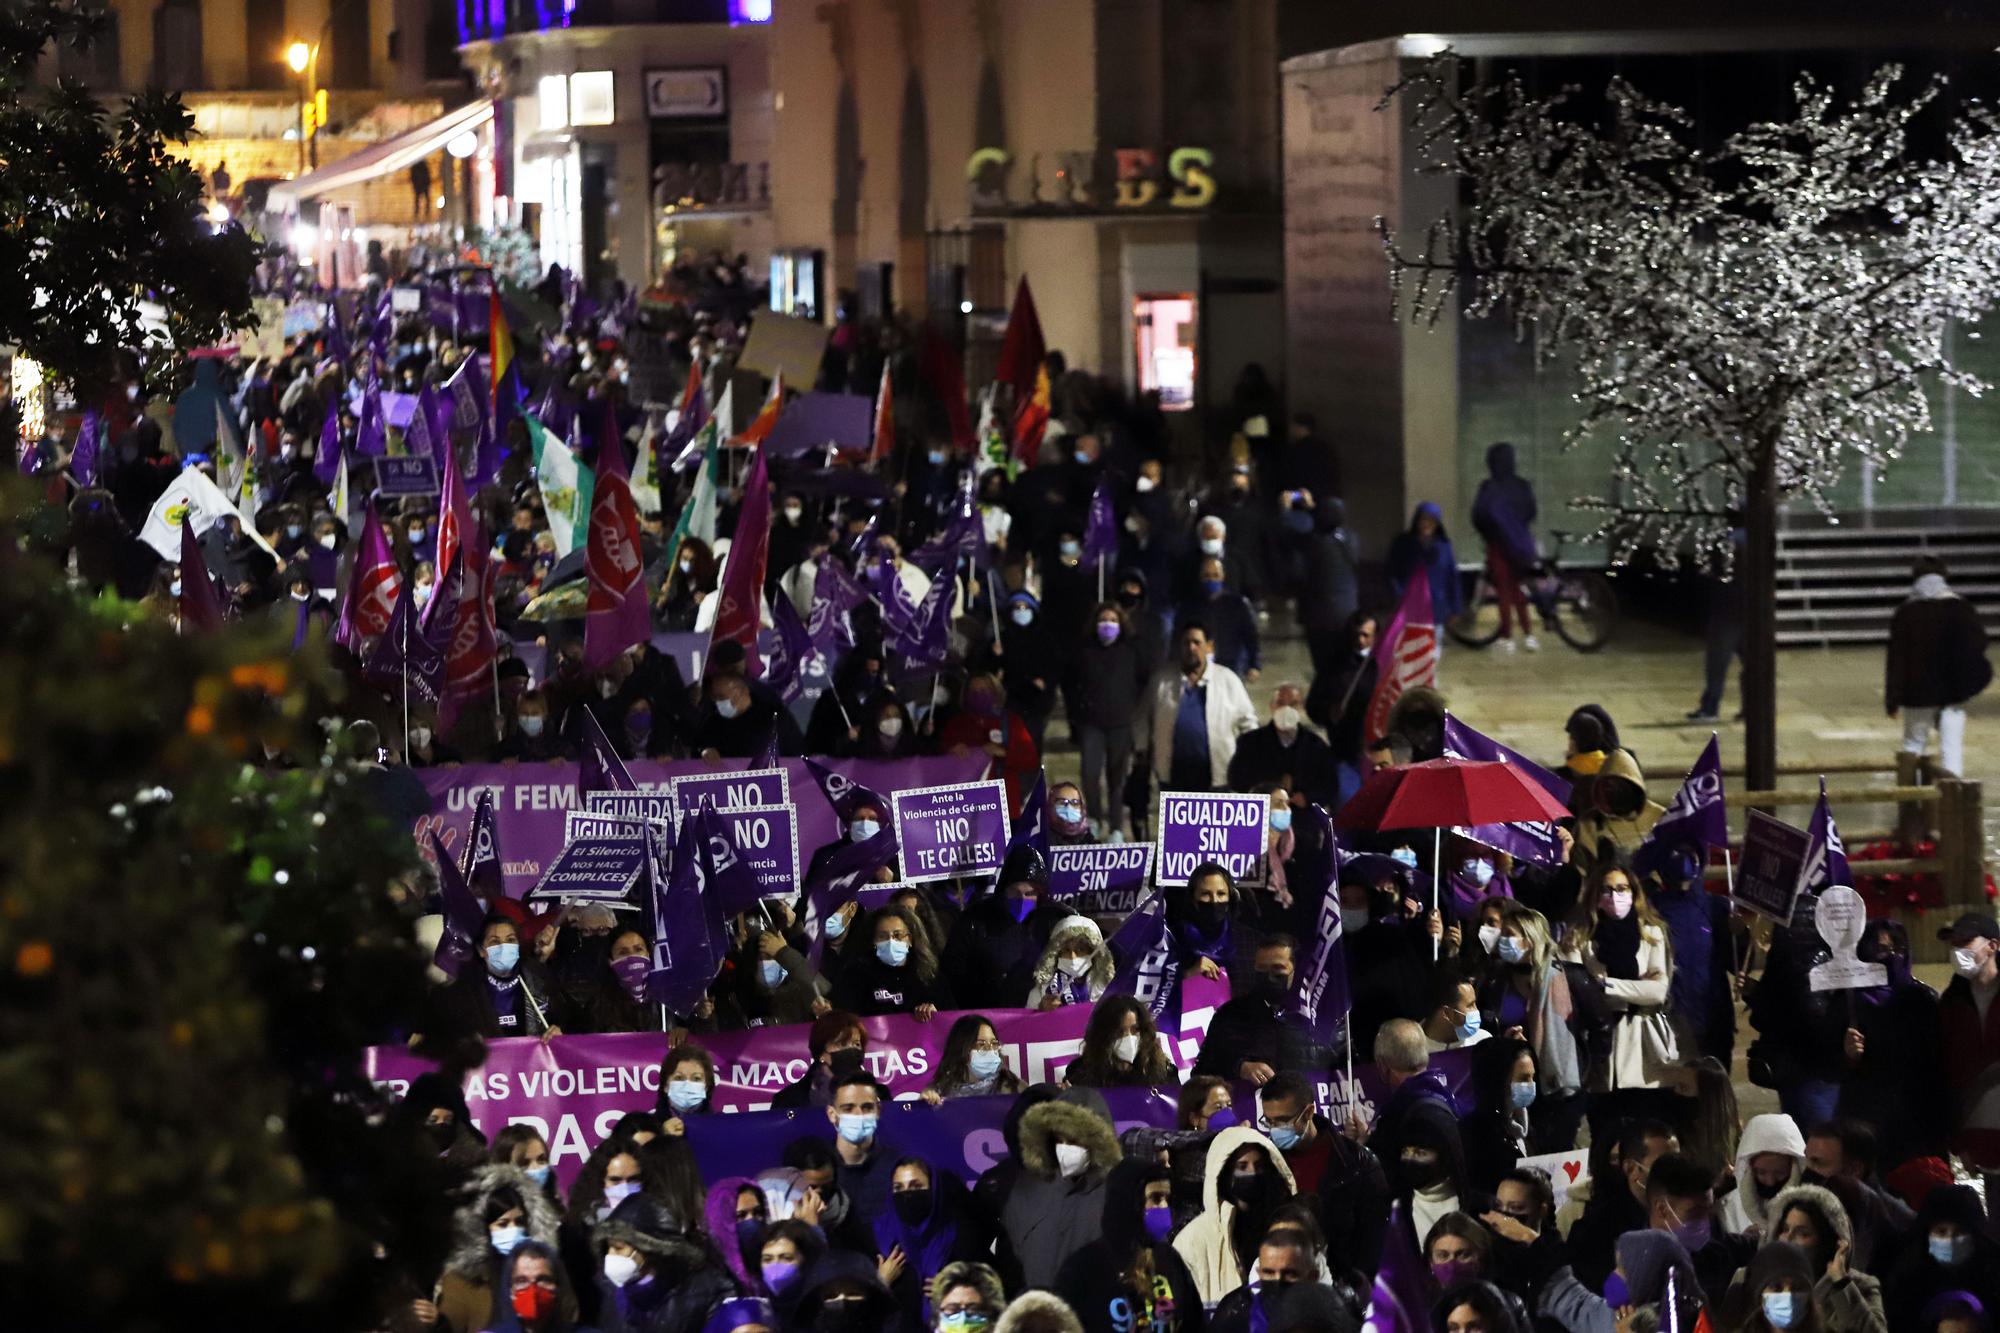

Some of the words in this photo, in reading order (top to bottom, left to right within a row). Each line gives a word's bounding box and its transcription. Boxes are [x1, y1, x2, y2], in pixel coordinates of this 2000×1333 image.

[727, 783, 763, 808] NO
[931, 794, 954, 805] Ante
[955, 792, 964, 802] la
[596, 797, 674, 822] IGUALDA
[903, 807, 947, 820] Violencia
[948, 805, 961, 814] de
[962, 802, 997, 814] Género
[1169, 801, 1260, 827] IGUALDAD
[734, 818, 771, 850] NO
[935, 817, 970, 844] ¡NO
[1199, 827, 1228, 852] SIN
[571, 846, 587, 857] El
[588, 846, 641, 858] Silencio
[917, 849, 937, 870] TE
[938, 842, 996, 868] CALLES!
[1052, 849, 1144, 873] IGUALDAD
[569, 860, 596, 870] NOS
[597, 860, 625, 870] HACE
[549, 871, 631, 884] COMPLICES
[757, 872, 792, 886] ujeres
[1079, 871, 1109, 892] SIN
[466, 1071, 511, 1101] AS
[731, 1047, 929, 1087] MACTAS
